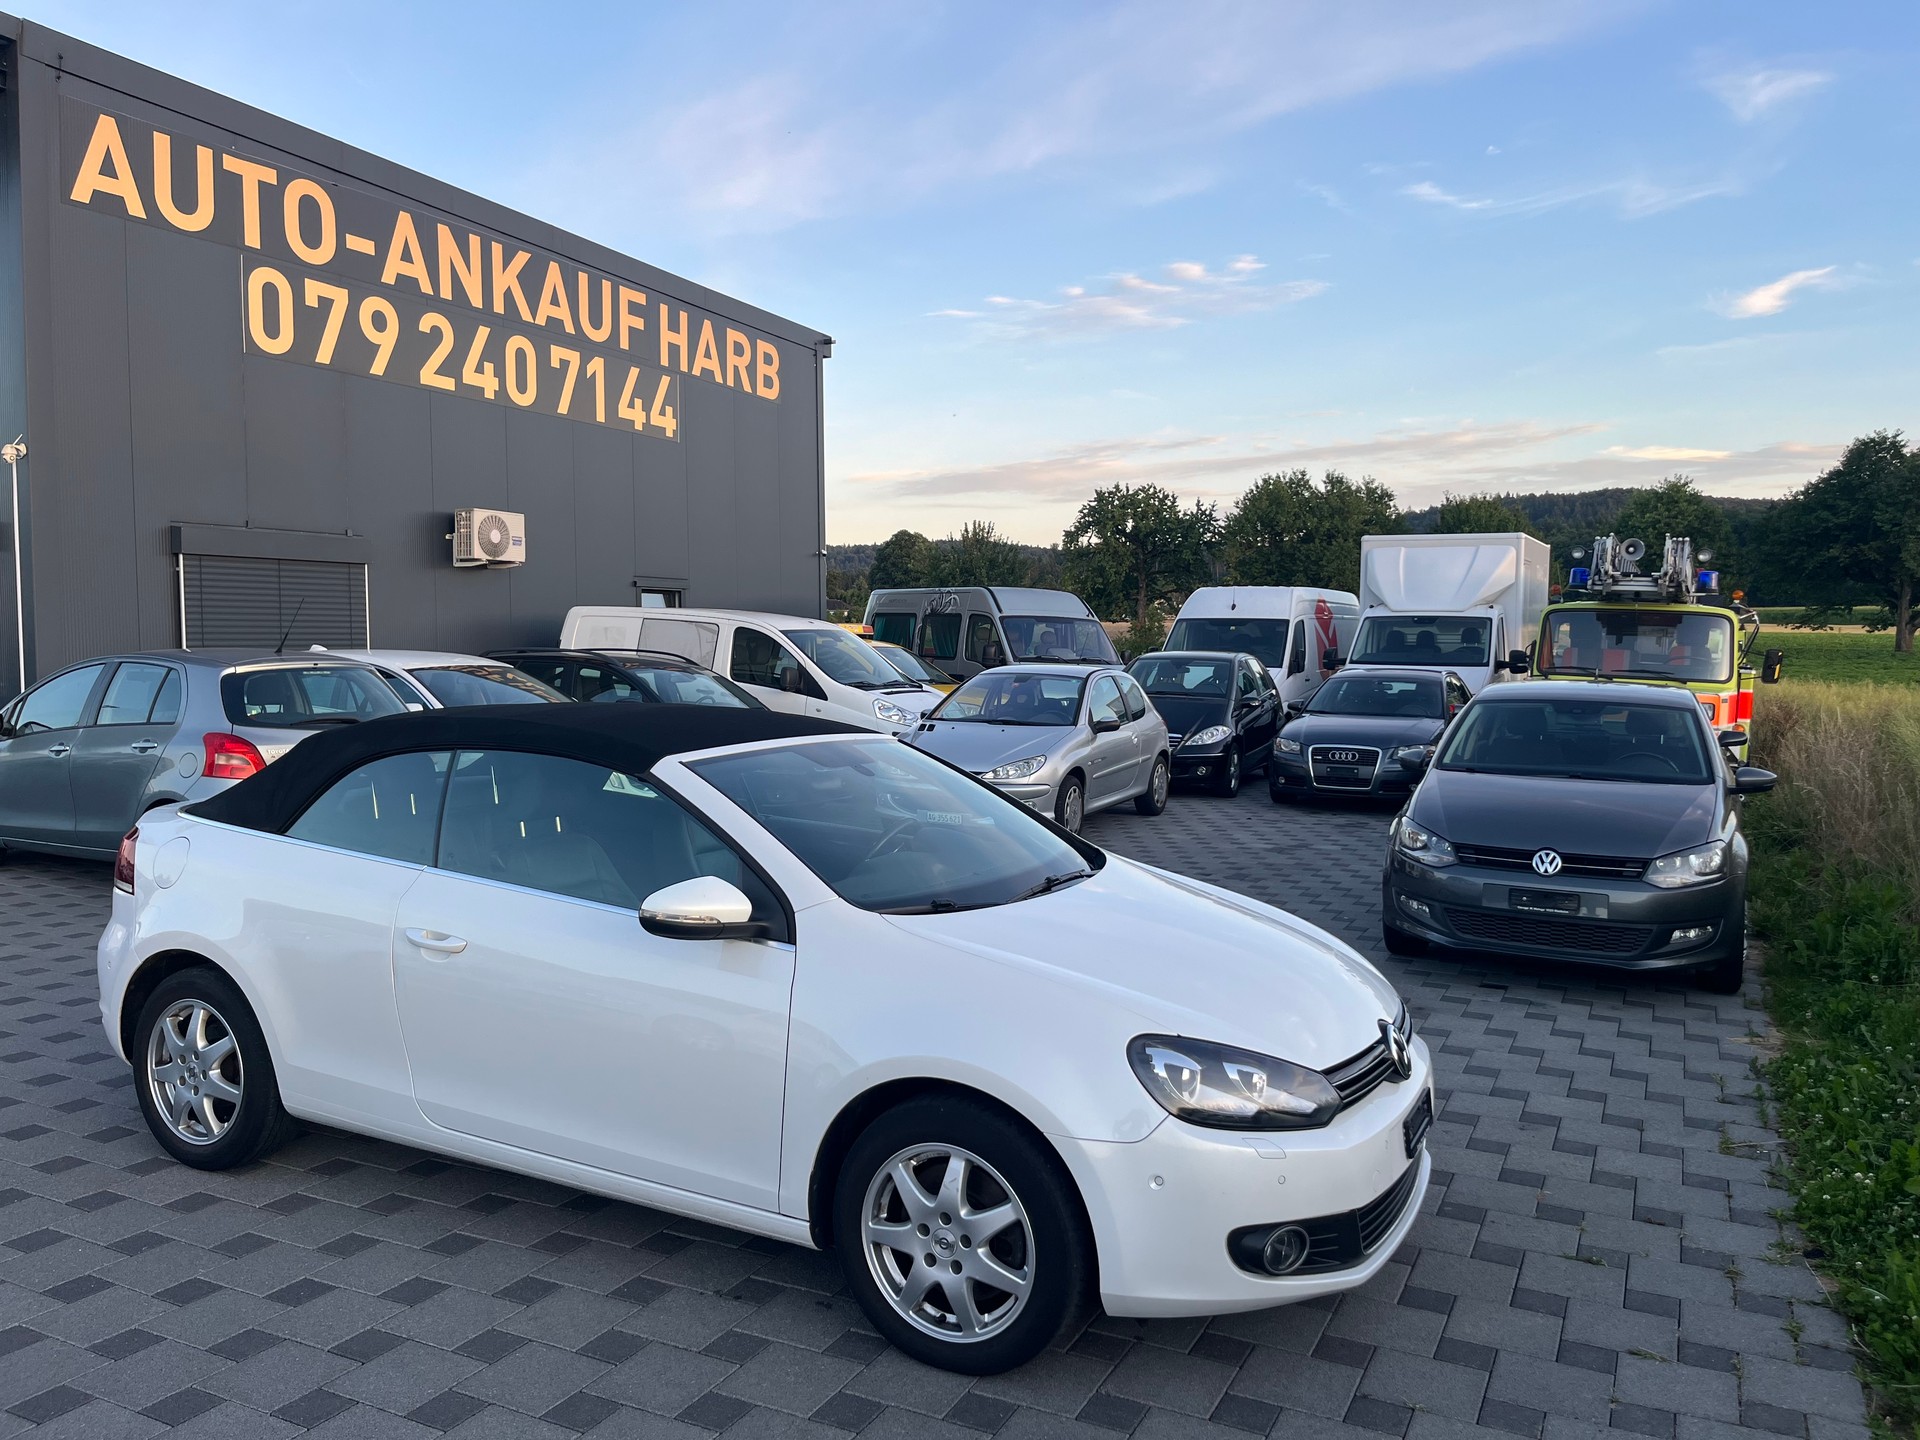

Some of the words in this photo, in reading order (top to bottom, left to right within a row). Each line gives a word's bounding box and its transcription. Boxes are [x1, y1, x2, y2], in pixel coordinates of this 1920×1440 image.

[71, 115, 647, 350] AUTO-ANKAUF
[659, 304, 781, 400] HARB
[248, 266, 400, 376] 079
[418, 313, 538, 407] 240
[550, 346, 606, 423] 71
[617, 368, 678, 438] 44
[1532, 850, 1562, 875] VW
